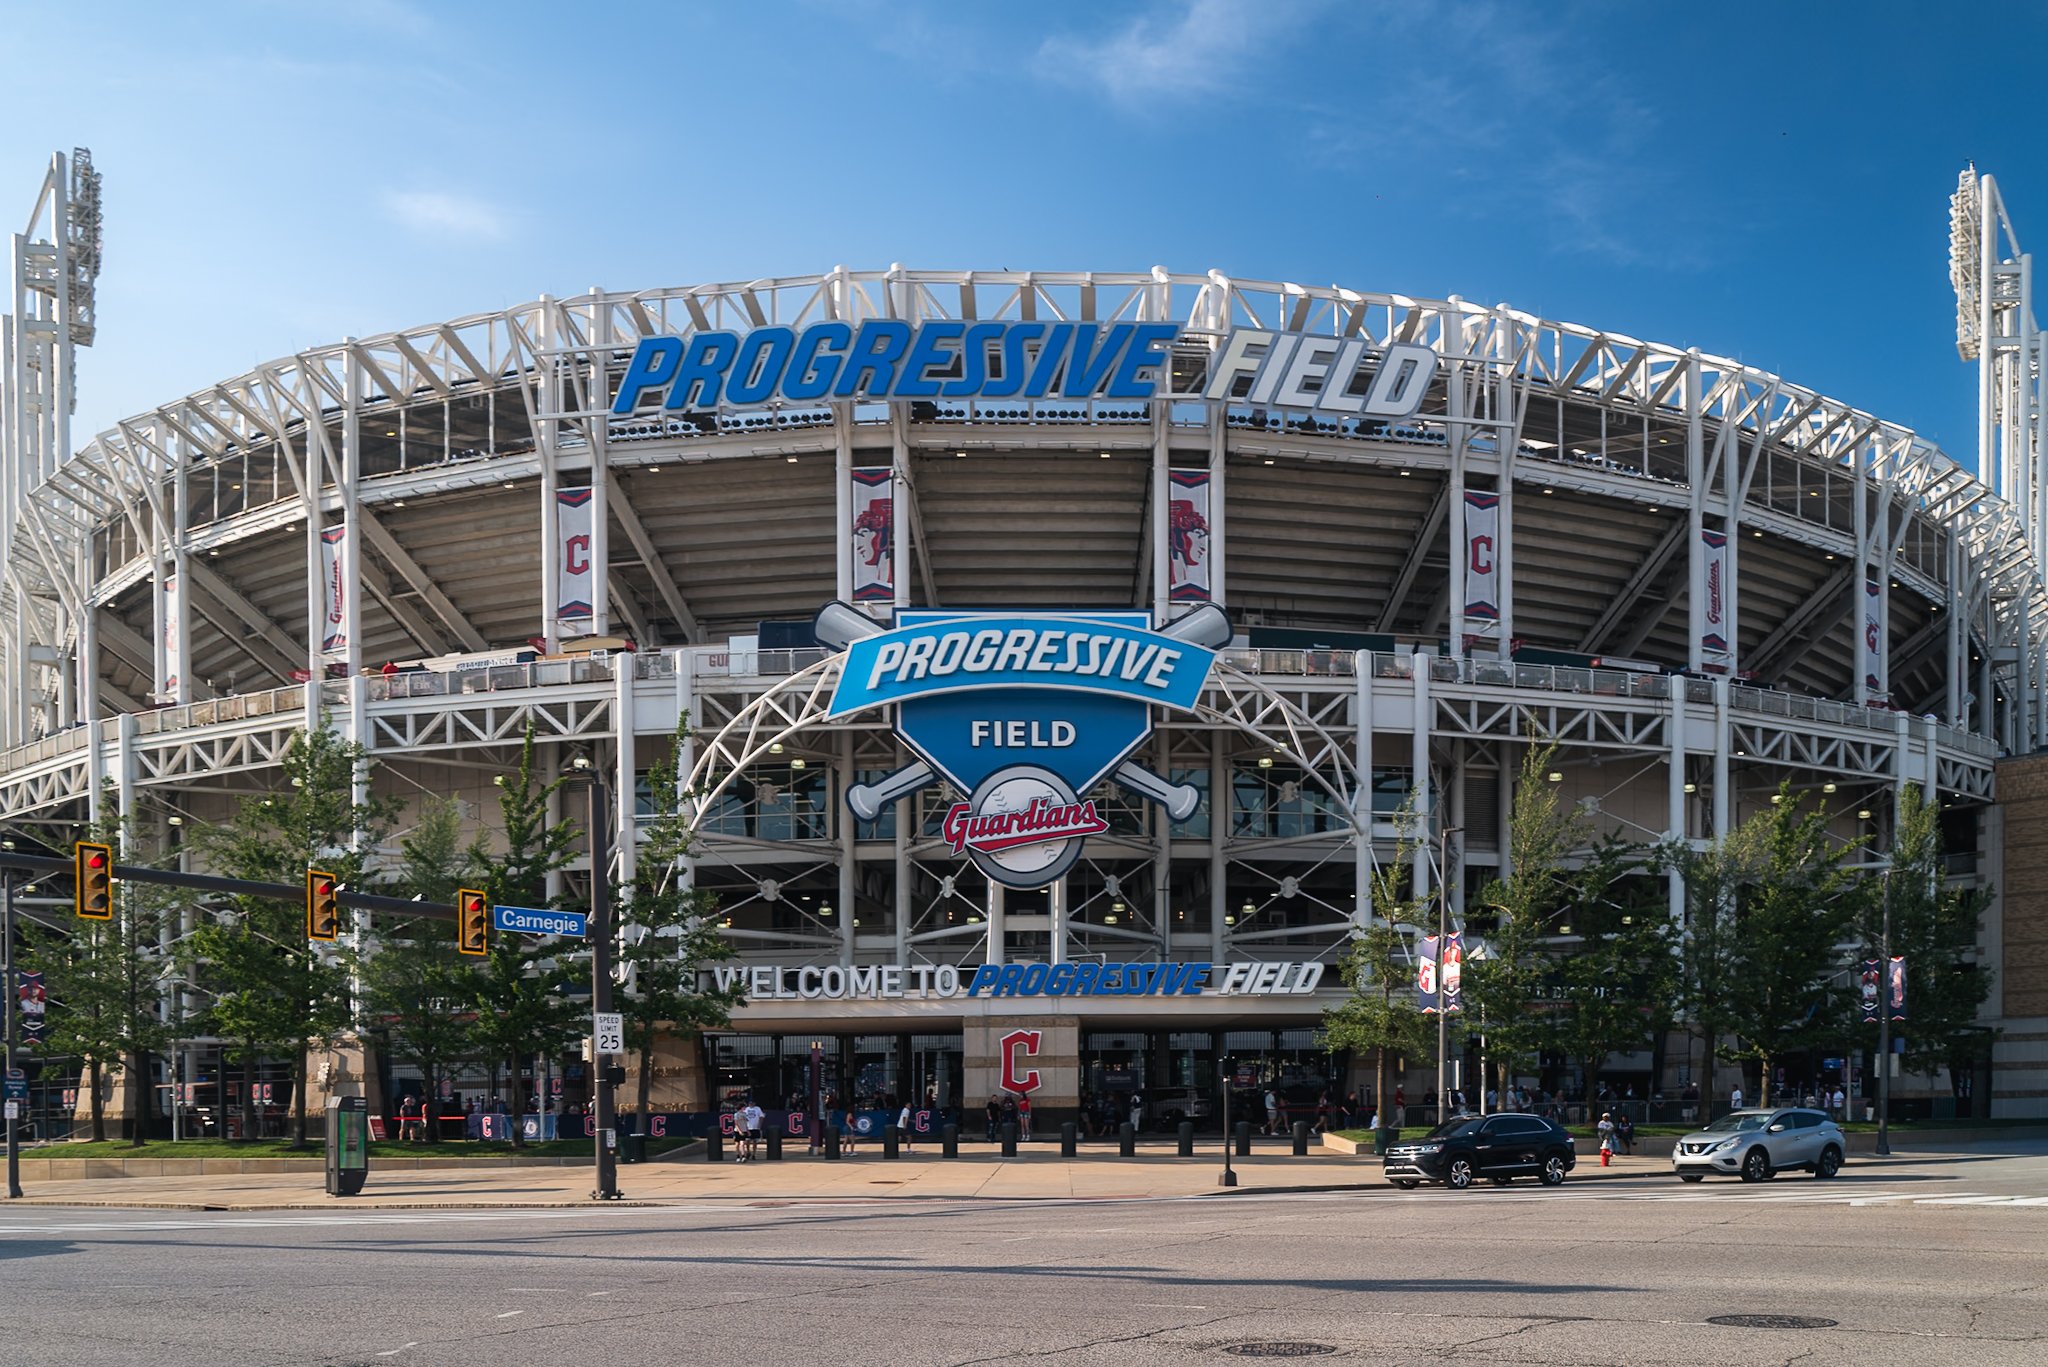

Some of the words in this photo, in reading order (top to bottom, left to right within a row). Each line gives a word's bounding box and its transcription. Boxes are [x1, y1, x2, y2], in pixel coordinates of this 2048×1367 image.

[610, 319, 1181, 416] PROGRESSIVE
[1205, 326, 1438, 417] FIELD
[566, 534, 590, 576] C
[1470, 534, 1494, 576] C
[1707, 559, 1722, 625] Guardians
[866, 628, 1182, 690] PROGRESSIVE
[971, 720, 1077, 748] FIELD
[942, 795, 1110, 858] Guardians
[502, 910, 579, 935] Carnegie
[714, 964, 903, 999] WELCOME
[911, 963, 960, 999] TO
[967, 962, 1213, 997] PROGRESSIVE
[1220, 961, 1326, 996] FIELD
[599, 1016, 620, 1025] SPEED
[600, 1035, 620, 1049] 25
[1000, 1029, 1042, 1095] C
[482, 1116, 492, 1138] C
[651, 1115, 667, 1137] C
[719, 1113, 734, 1135] C
[788, 1112, 804, 1135] C
[915, 1110, 931, 1133] C
